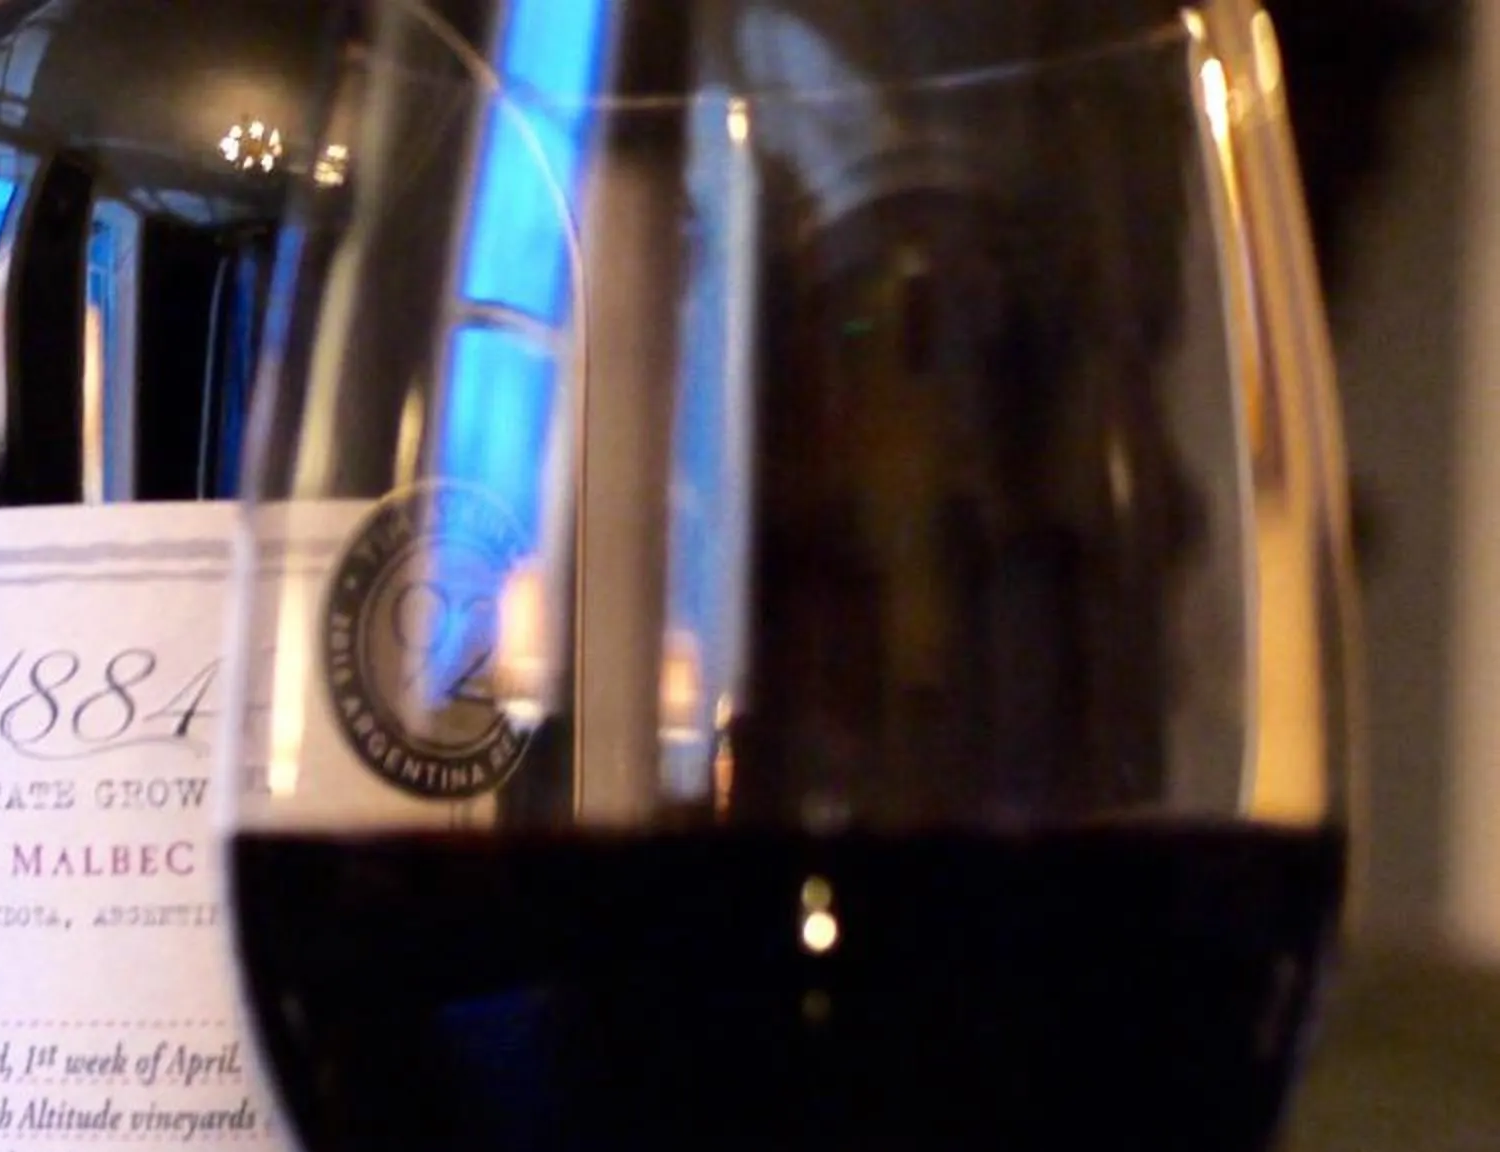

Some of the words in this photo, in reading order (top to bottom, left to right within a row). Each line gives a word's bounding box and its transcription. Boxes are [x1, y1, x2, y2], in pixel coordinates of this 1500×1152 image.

[94, 776, 214, 811] GROW
[10, 840, 197, 878] MALBEC
[64, 1041, 129, 1076] week
[135, 1040, 169, 1087] of
[17, 1097, 124, 1132] Altitude
[130, 1096, 257, 1143] vineyards
